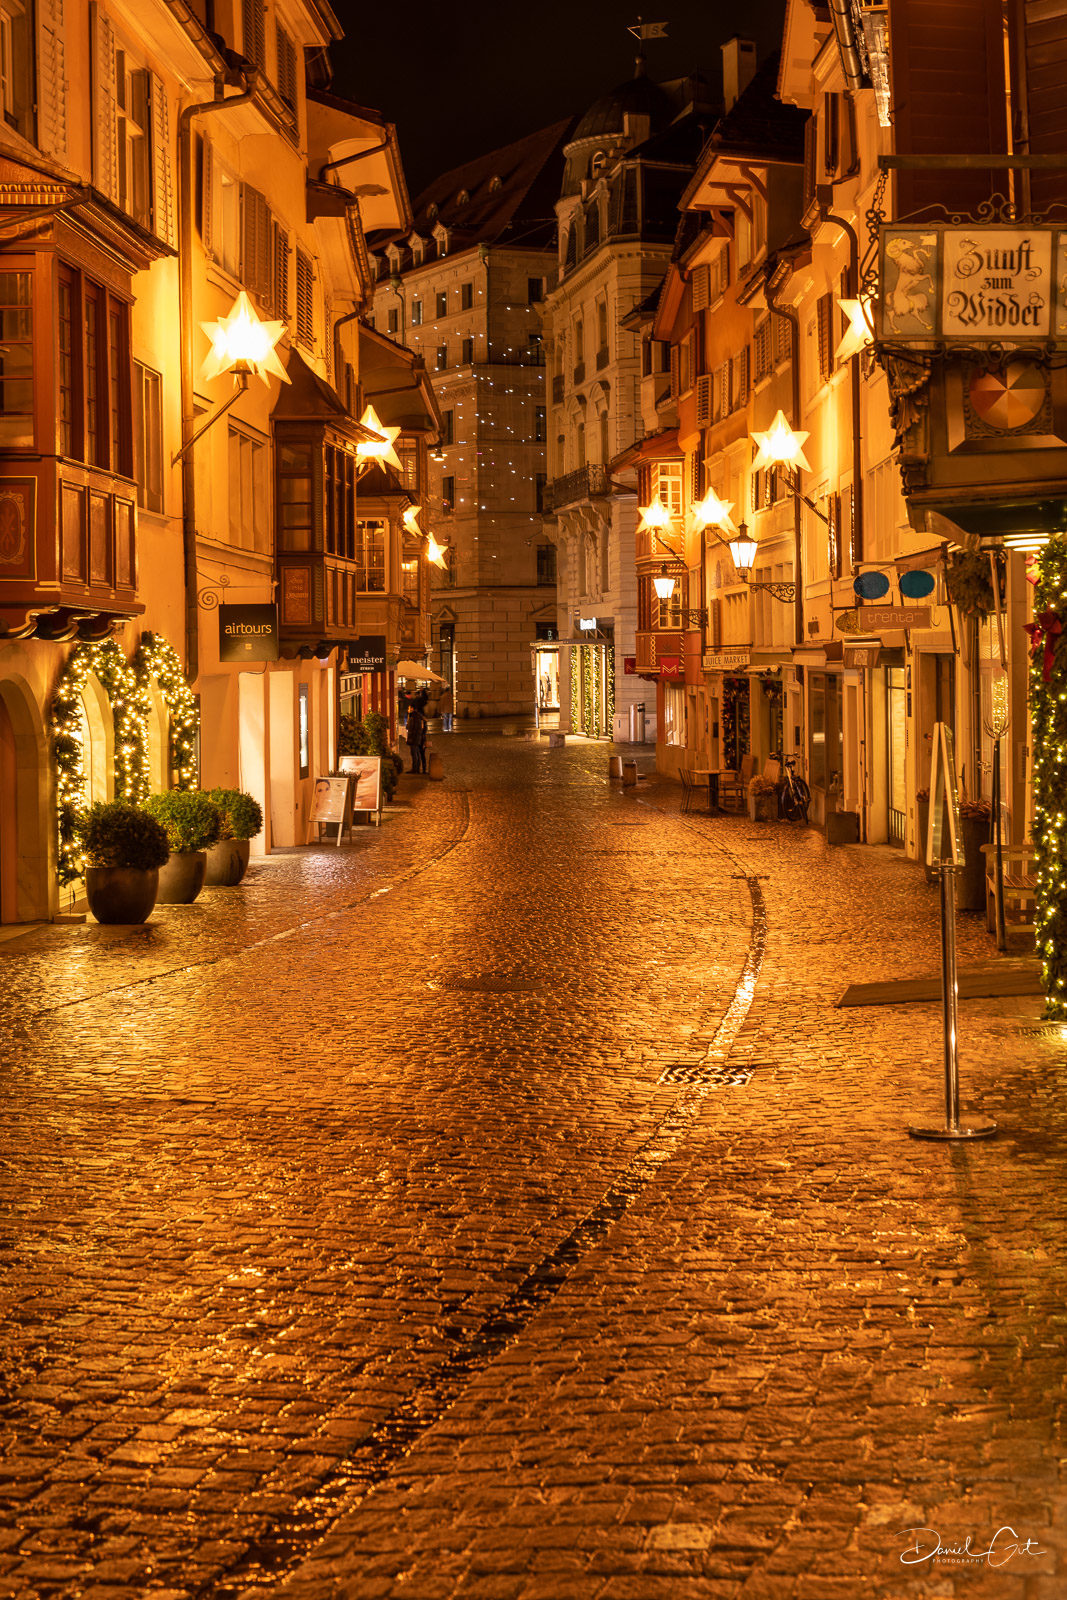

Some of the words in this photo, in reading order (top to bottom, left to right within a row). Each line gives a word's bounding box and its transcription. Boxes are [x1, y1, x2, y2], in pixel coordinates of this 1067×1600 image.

[954, 238, 1043, 282] Zunft
[981, 277, 1014, 290] zum
[947, 290, 1045, 328] Widder
[867, 612, 914, 624] trenta
[224, 622, 272, 634] airtours
[350, 656, 385, 664] meister
[705, 656, 722, 666] JUICE
[724, 655, 748, 665] MARKET
